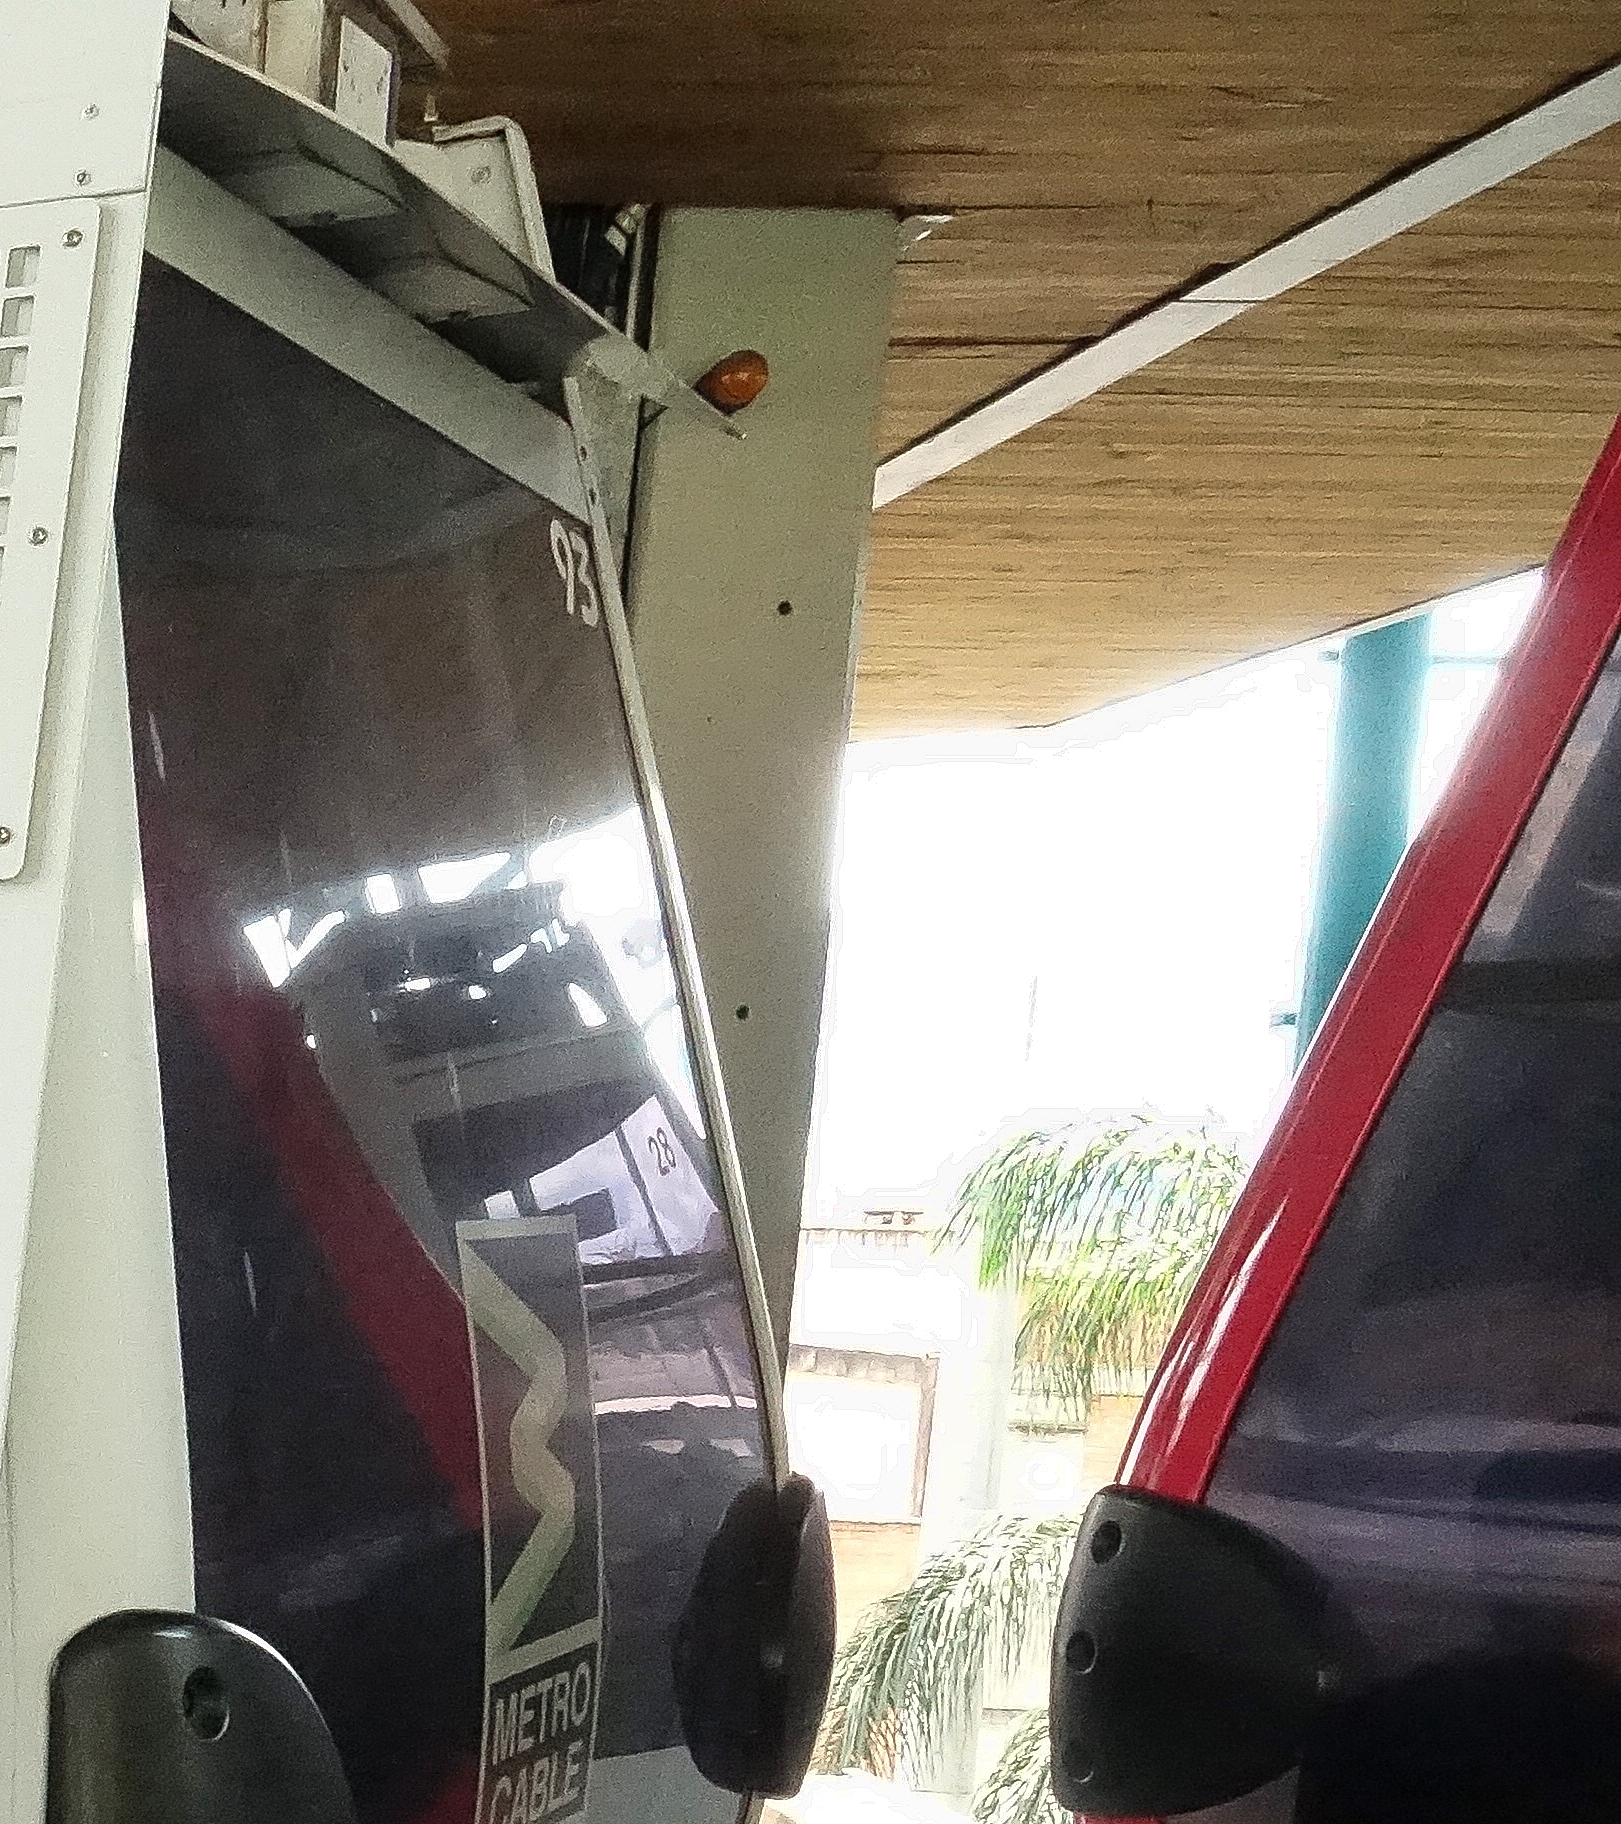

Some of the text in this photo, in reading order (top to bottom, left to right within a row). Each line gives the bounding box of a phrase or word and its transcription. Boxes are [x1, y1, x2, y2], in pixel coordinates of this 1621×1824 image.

[550, 519, 598, 627] 93
[647, 1127, 676, 1176] 28
[492, 1662, 591, 1766] METRO
